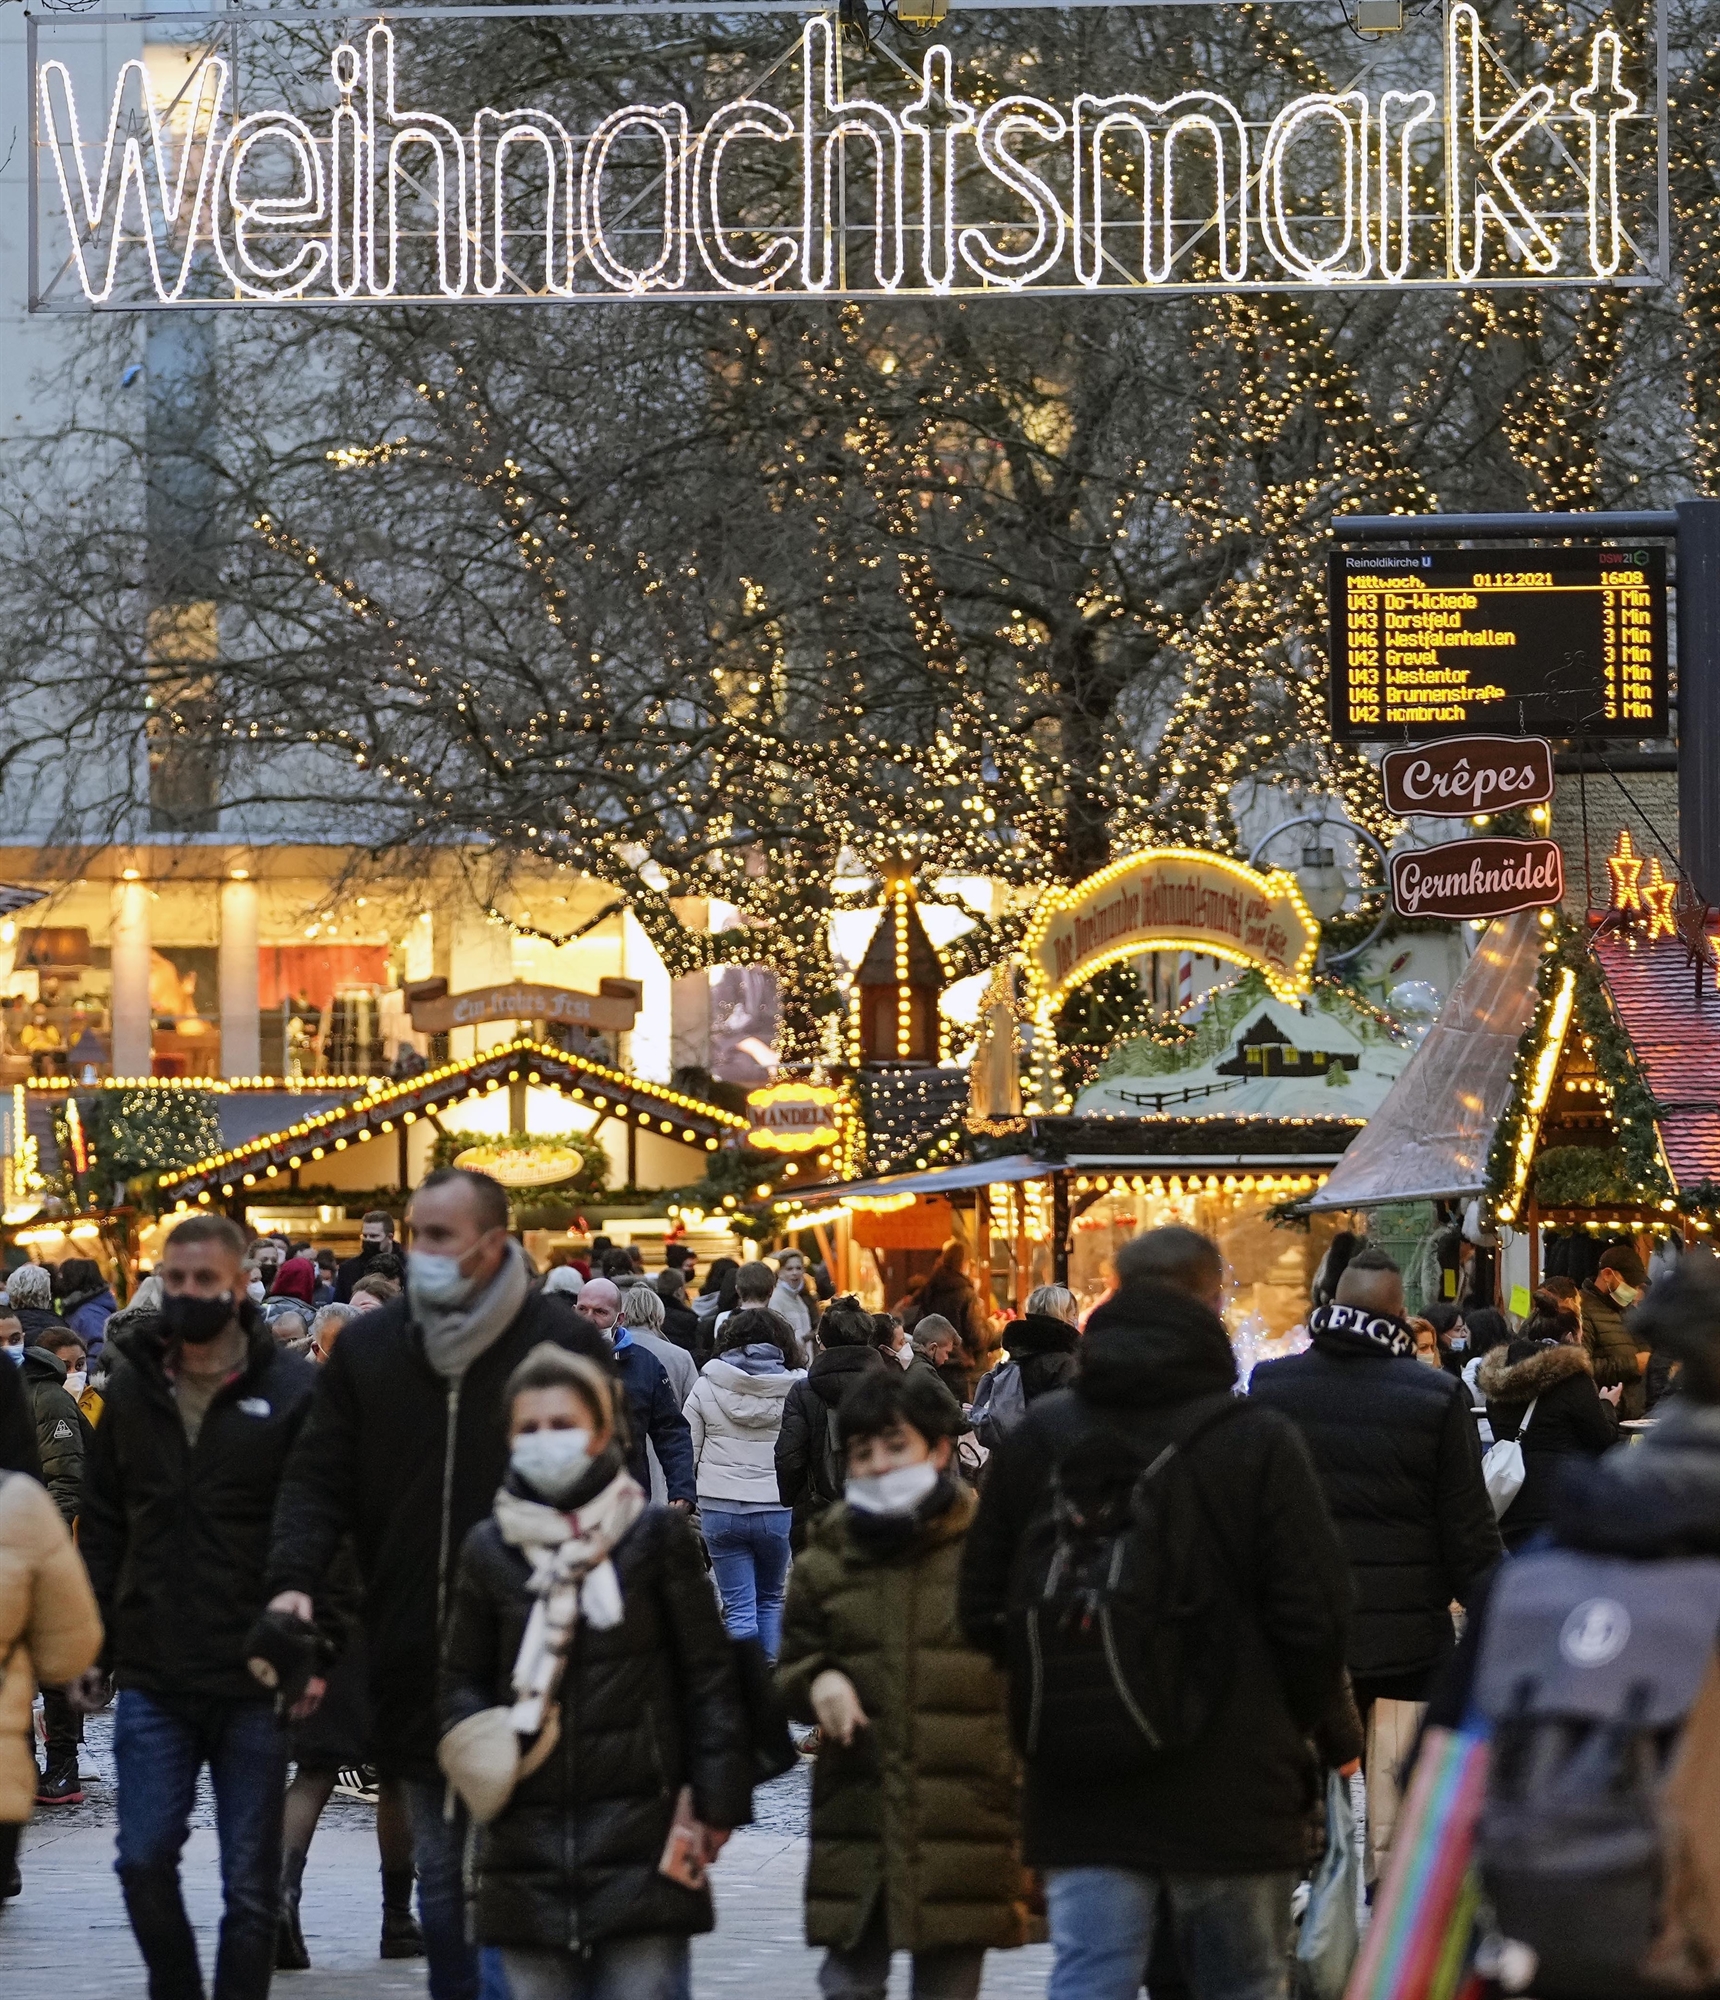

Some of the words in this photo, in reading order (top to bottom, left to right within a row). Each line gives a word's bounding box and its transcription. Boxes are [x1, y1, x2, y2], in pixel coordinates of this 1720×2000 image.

[40, 3, 1638, 303] Weihnachtsmarkt
[1346, 558, 1420, 568] Reinoldikirche
[1347, 575, 1427, 589] Mittwoch,
[1473, 573, 1553, 587] 01.12.2021
[1601, 571, 1644, 585] 16:08
[1347, 594, 1378, 611] U43
[1384, 593, 1478, 610] Do-Wickede
[1603, 590, 1615, 607] 3
[1621, 590, 1651, 606] Min
[1347, 613, 1379, 629] U43
[1385, 611, 1461, 630] Dorstfeld
[1603, 609, 1615, 625] 3
[1621, 608, 1651, 625] Min
[1347, 631, 1379, 648] U46
[1385, 630, 1516, 650] Westfalenhallen
[1603, 627, 1615, 644] 3
[1621, 627, 1651, 643] Min
[1348, 650, 1380, 667] U42
[1385, 649, 1440, 666] Grevel
[1603, 645, 1616, 662] 3
[1622, 645, 1652, 662] Min
[1348, 669, 1380, 685] U43
[1385, 667, 1471, 684] Westentor
[1603, 664, 1616, 681] 4
[1622, 664, 1652, 680] Min
[1348, 687, 1380, 704] U46
[1386, 685, 1506, 703] Brunnenstraße
[1604, 683, 1616, 700] 4
[1623, 682, 1652, 699] Min
[1349, 706, 1380, 722] U42
[1604, 702, 1617, 719] 5
[1623, 701, 1653, 718] Min
[1402, 758, 1536, 807] Crêpes
[1400, 850, 1558, 912] Germknödel
[750, 1107, 834, 1127] MANDELN
